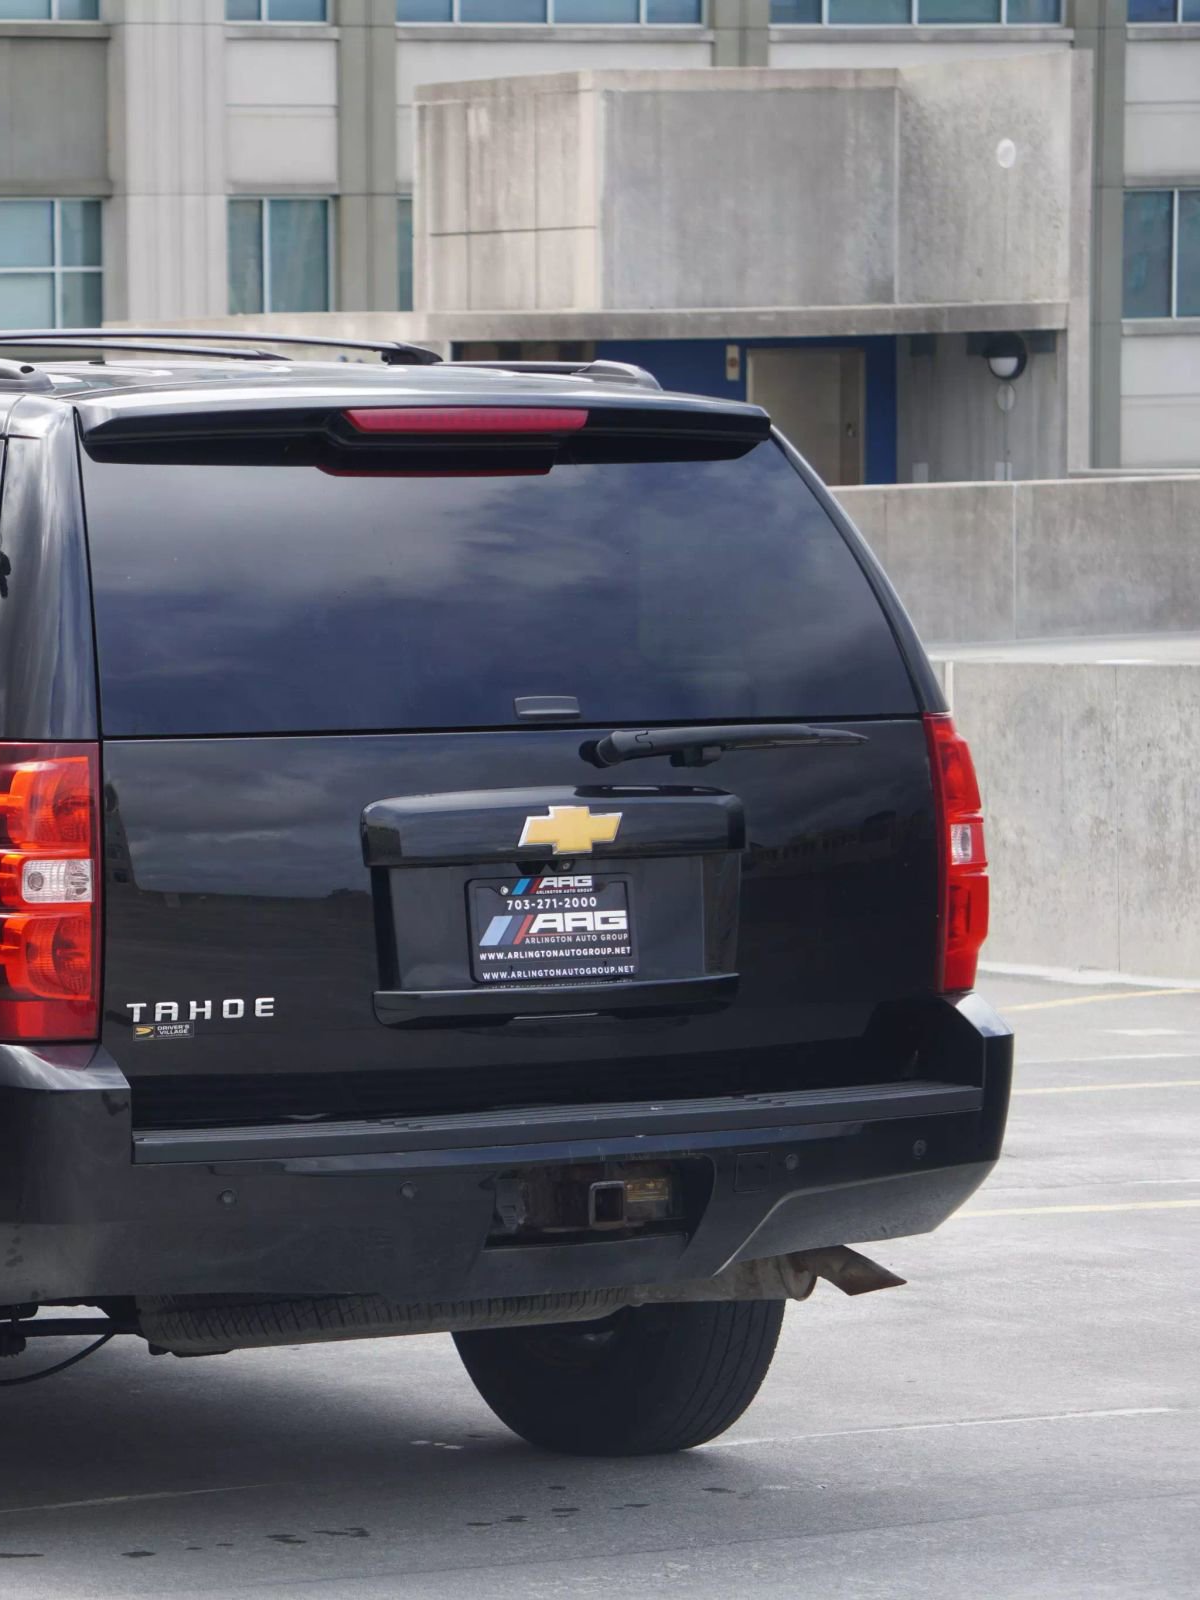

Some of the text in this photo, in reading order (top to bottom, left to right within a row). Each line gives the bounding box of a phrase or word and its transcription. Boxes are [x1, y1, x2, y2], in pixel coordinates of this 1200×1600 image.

[506, 896, 598, 911] 703-271-2000
[529, 910, 628, 934] AAG
[525, 932, 629, 944] ARLINGTON AUTO GROUP
[479, 946, 632, 961] WWW.ARLINGTONAUTOGROUP.NET
[482, 965, 635, 980] WWW.ARLINGTONAUTOGROUP.NET
[126, 997, 275, 1023] TAHOE
